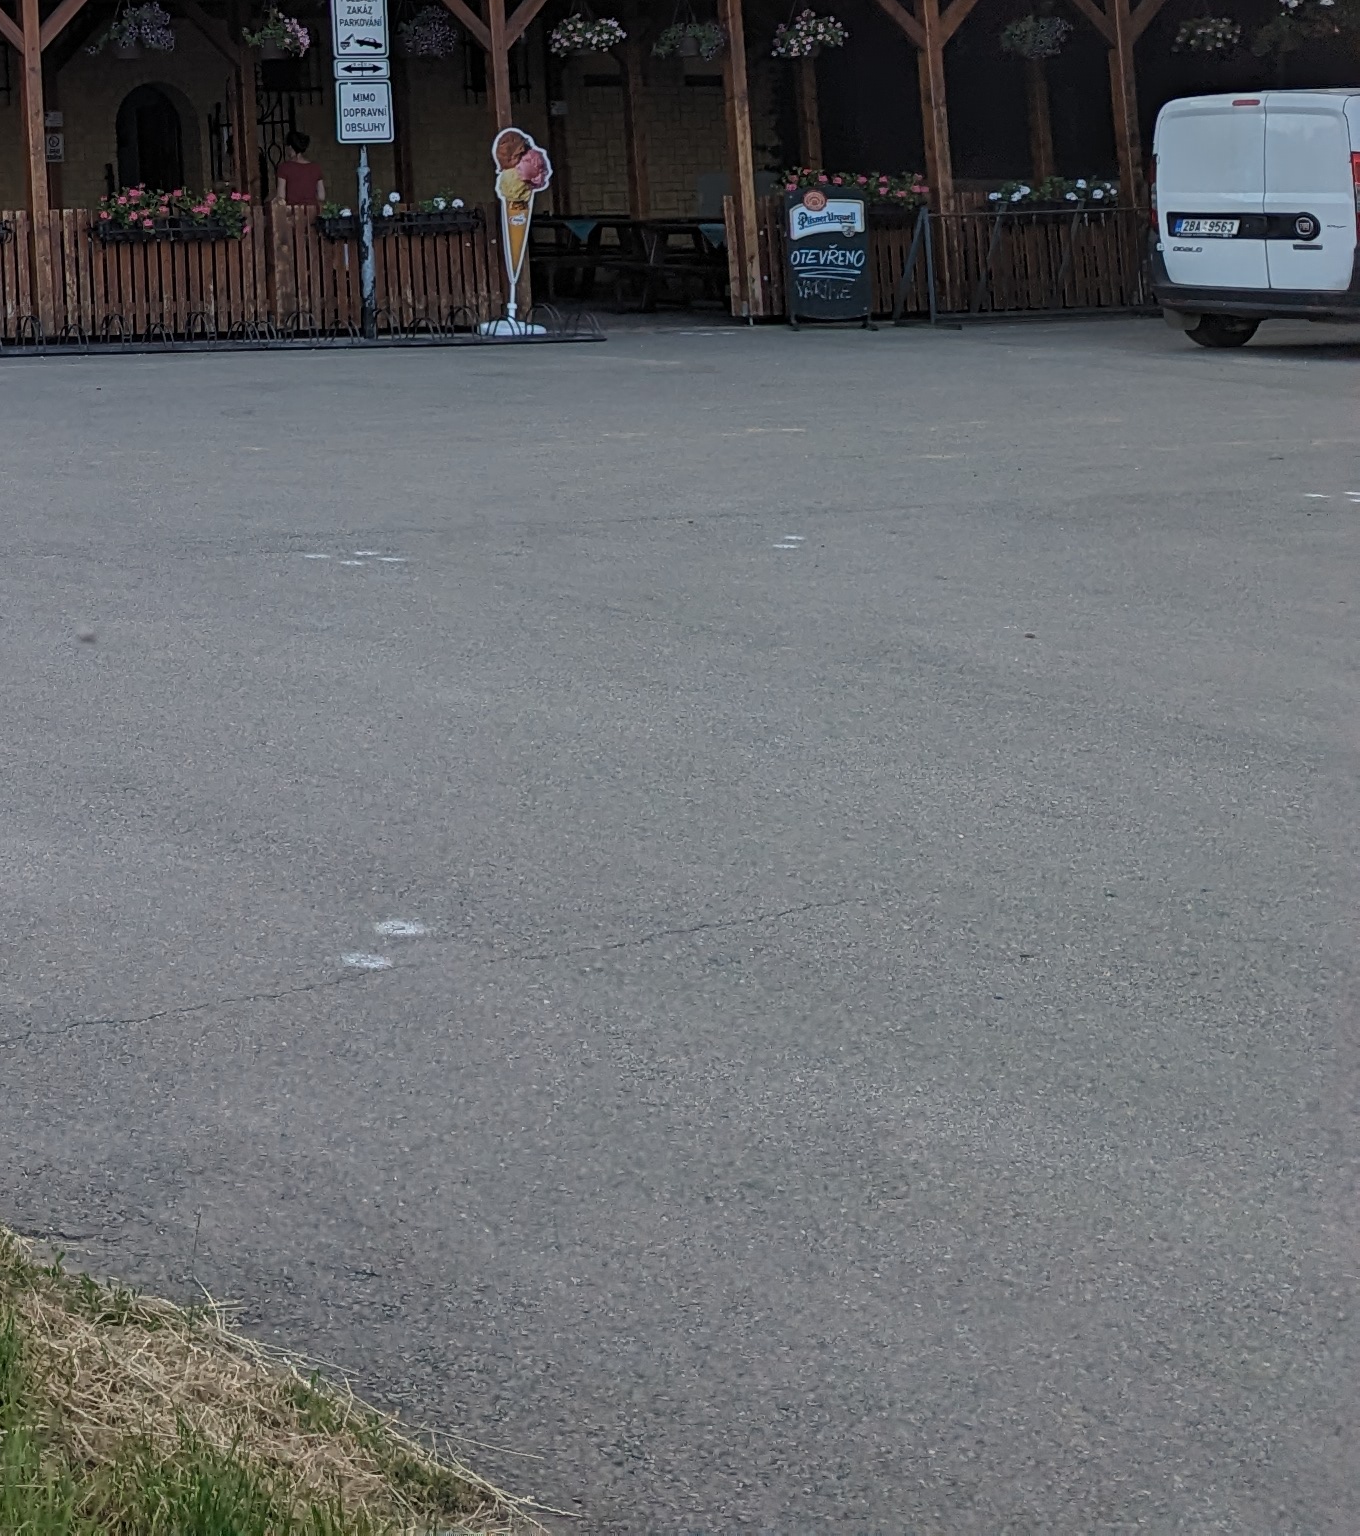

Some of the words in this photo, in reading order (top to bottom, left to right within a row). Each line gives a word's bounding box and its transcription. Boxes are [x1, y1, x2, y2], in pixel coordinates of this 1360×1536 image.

[346, 4, 373, 15] ZAKÁZ
[339, 16, 383, 27] PARKOVÁNÍ
[352, 93, 376, 102] MIMO
[343, 105, 387, 117] DOPRAVNÍ
[345, 122, 386, 132] OBSLUHY
[797, 212, 827, 230] Pilsner
[827, 211, 856, 225] Urquell
[1183, 221, 1200, 232] 2BA
[1208, 221, 1234, 233] 9563
[790, 244, 866, 267] OTEVŘENO
